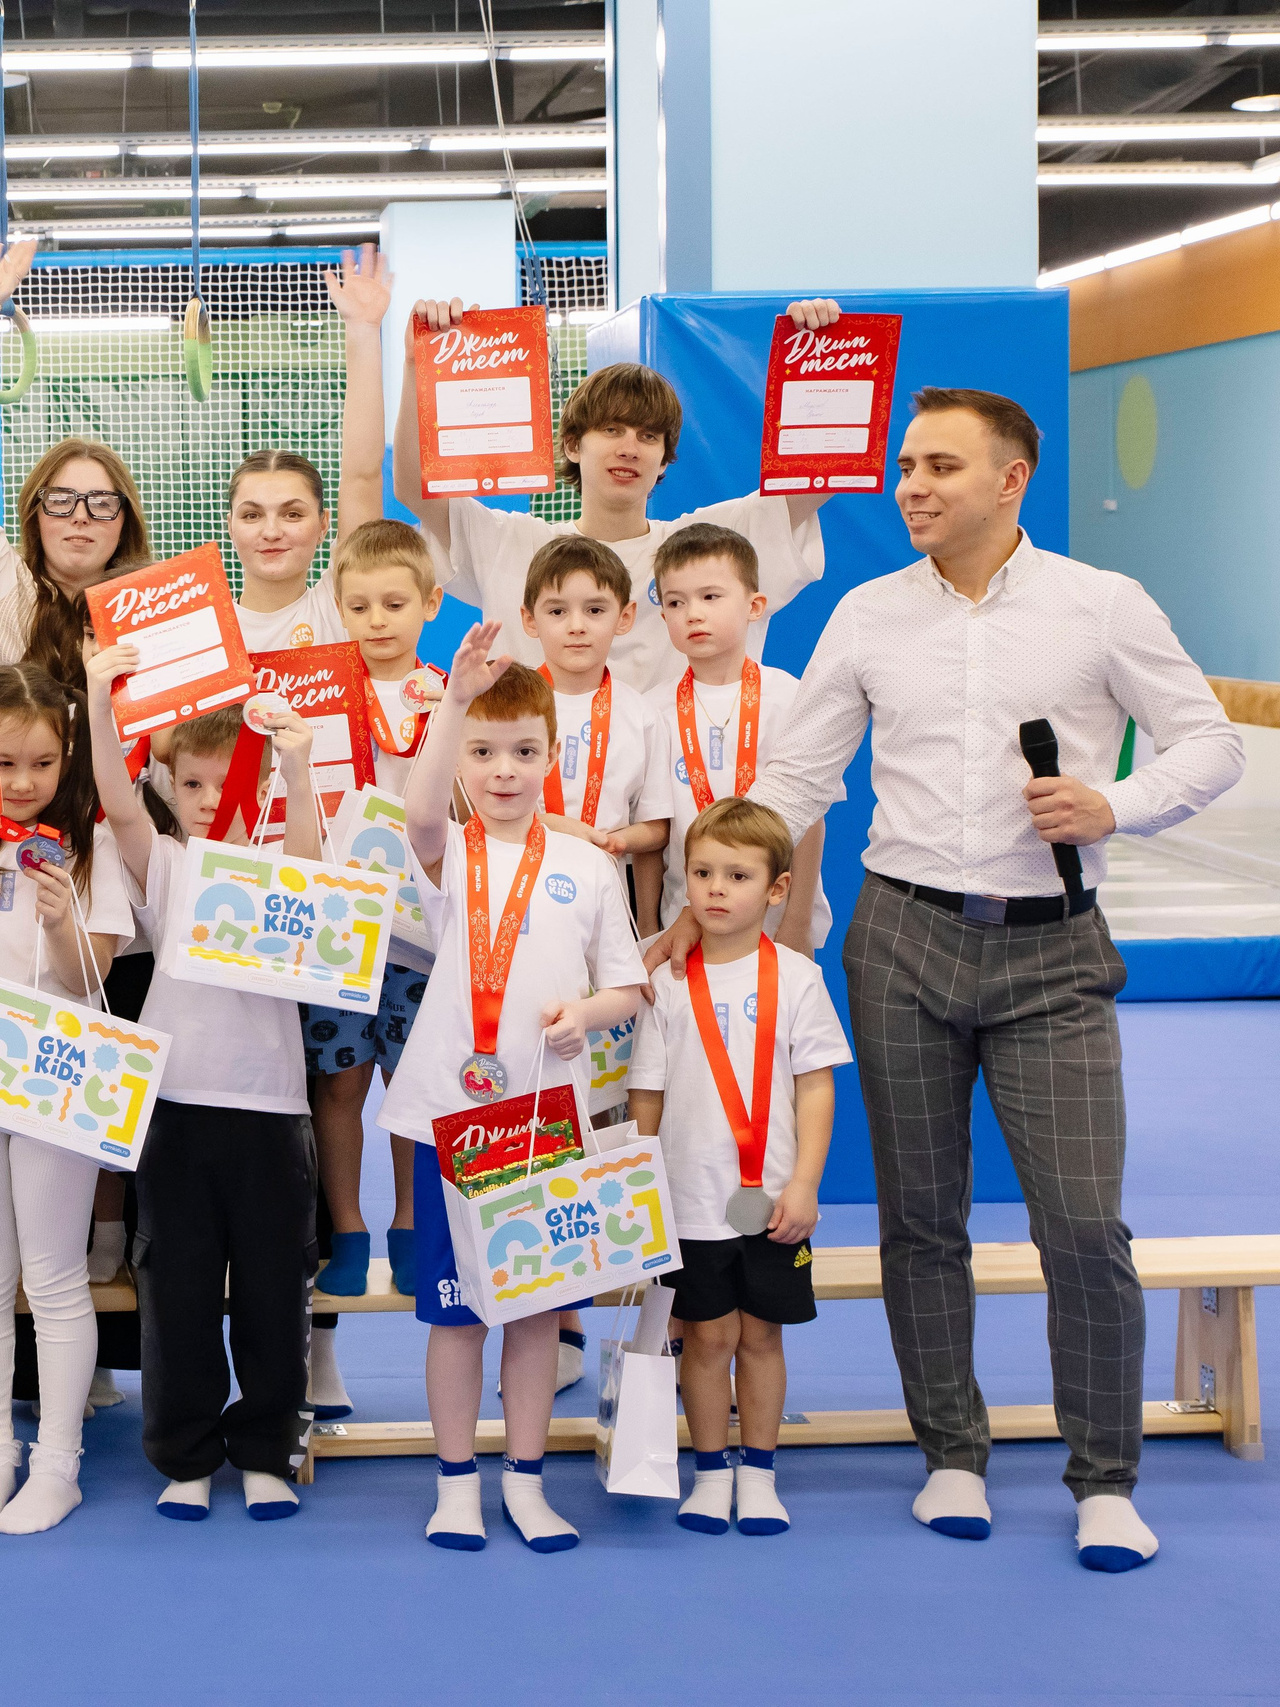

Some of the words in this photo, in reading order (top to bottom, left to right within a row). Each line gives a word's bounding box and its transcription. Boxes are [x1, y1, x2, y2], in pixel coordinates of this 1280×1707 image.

[429, 328, 519, 365] Джим
[784, 328, 870, 364] Джим
[451, 348, 530, 374] тест
[800, 350, 879, 374] тест
[105, 572, 195, 623] Джим
[131, 582, 210, 625] тест
[286, 684, 345, 709] ест
[547, 877, 572, 890] GYM
[265, 893, 316, 922] GYM
[38, 1036, 86, 1068] GYM
[545, 1199, 597, 1228] GYM
[437, 1279, 460, 1294] GY
